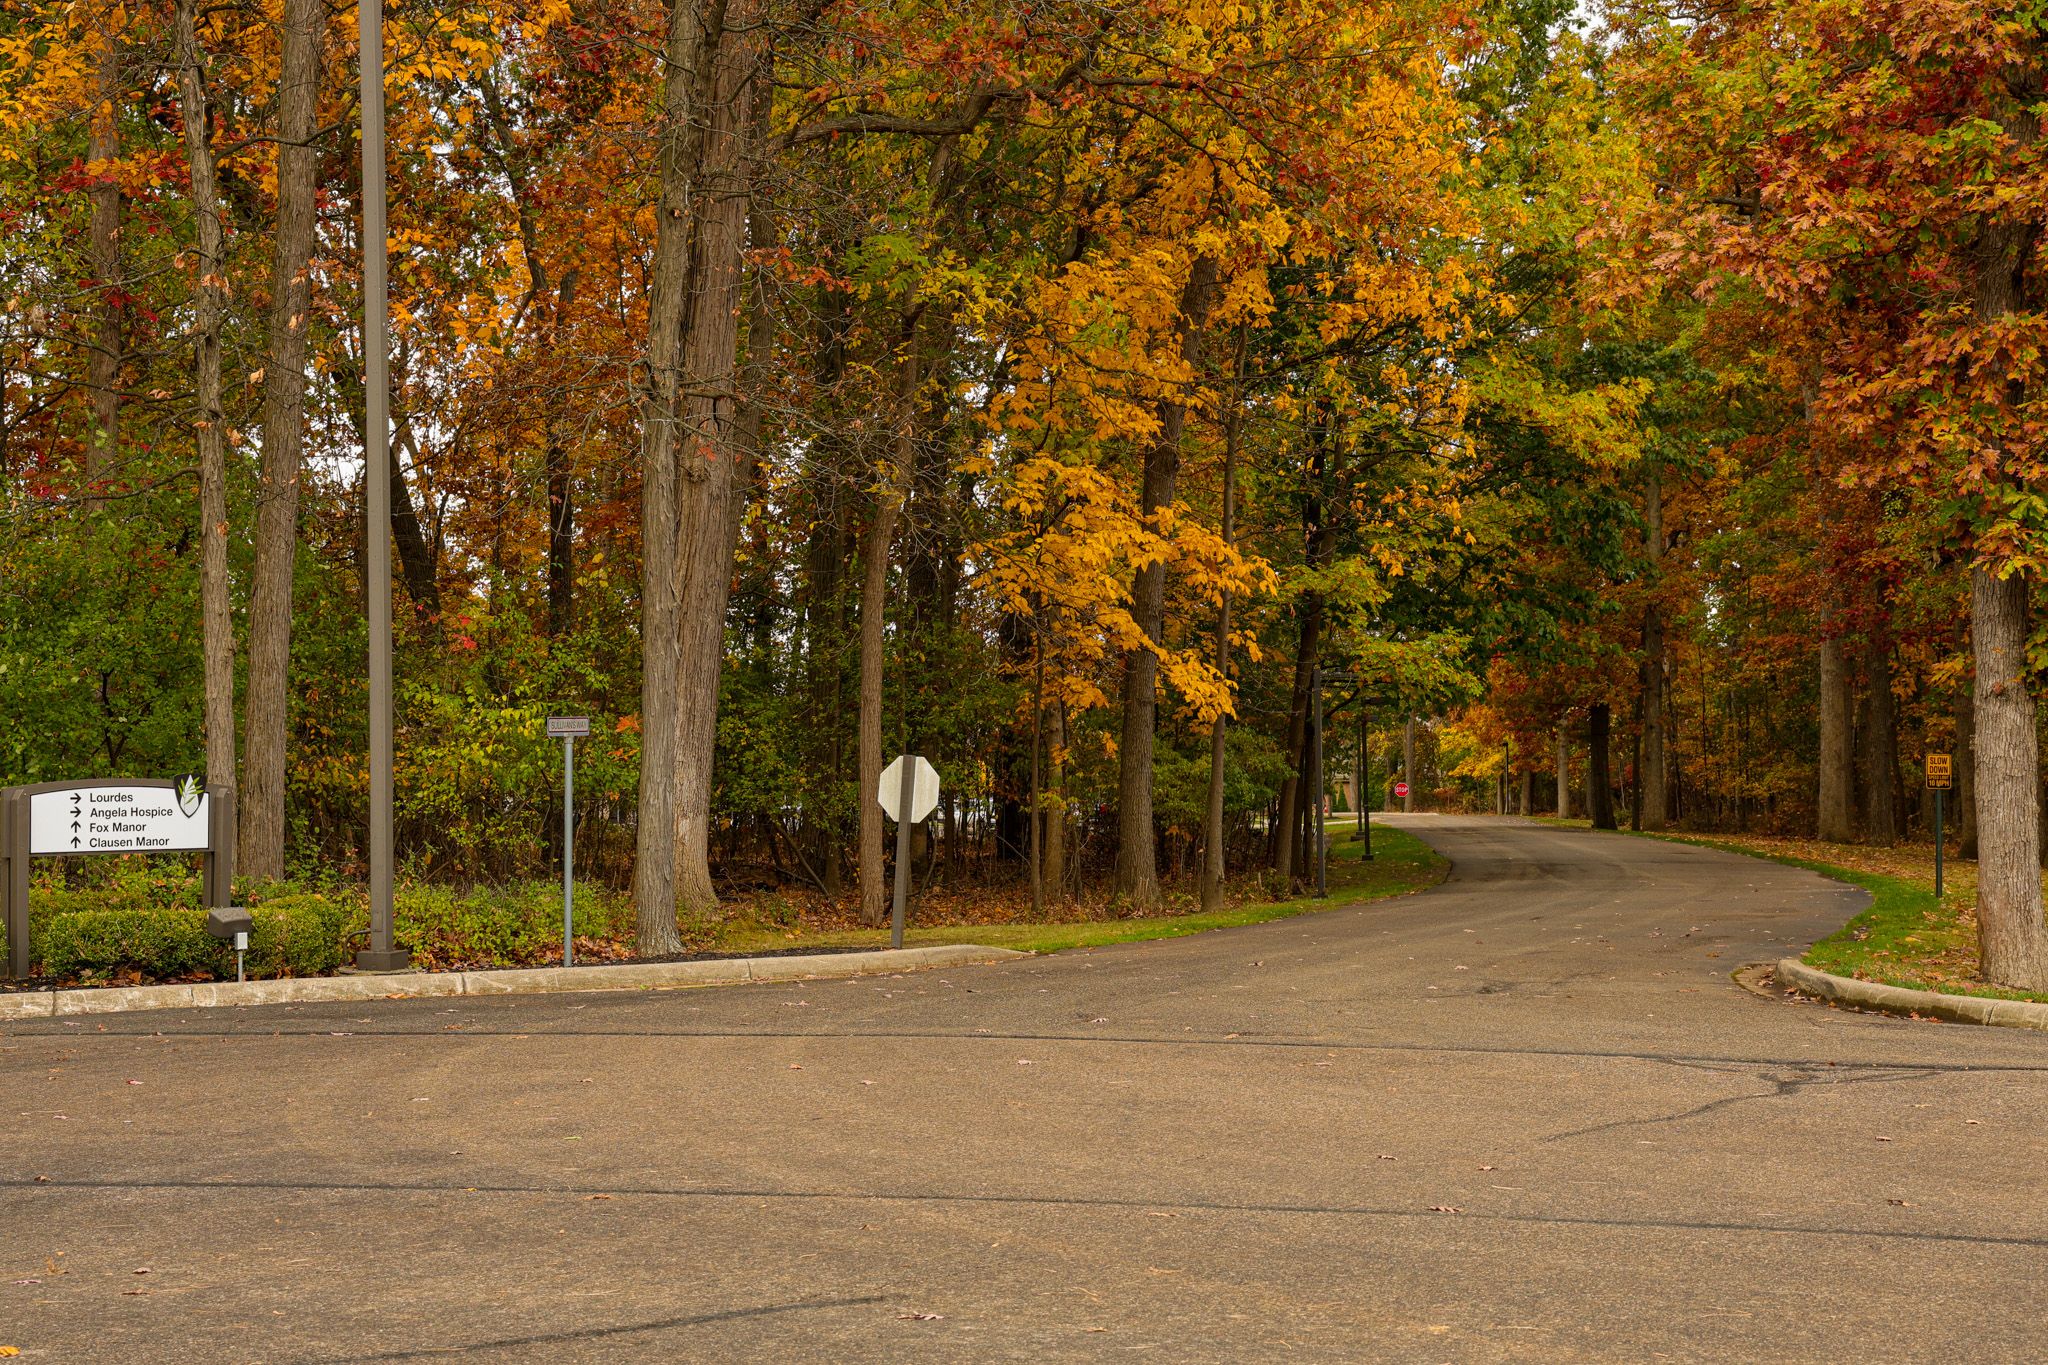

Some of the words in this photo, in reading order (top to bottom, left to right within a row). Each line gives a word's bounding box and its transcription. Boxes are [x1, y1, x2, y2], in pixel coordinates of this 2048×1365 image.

[1929, 756, 1948, 765] SLOW
[1929, 765, 1949, 774] DOWN
[89, 792, 134, 803] Lourdes
[90, 807, 127, 819] Angela
[130, 806, 173, 819] Hospice
[89, 822, 109, 833] Fox
[112, 822, 147, 832] Manor
[89, 837, 133, 848] Clausen
[136, 836, 170, 847] Manor
